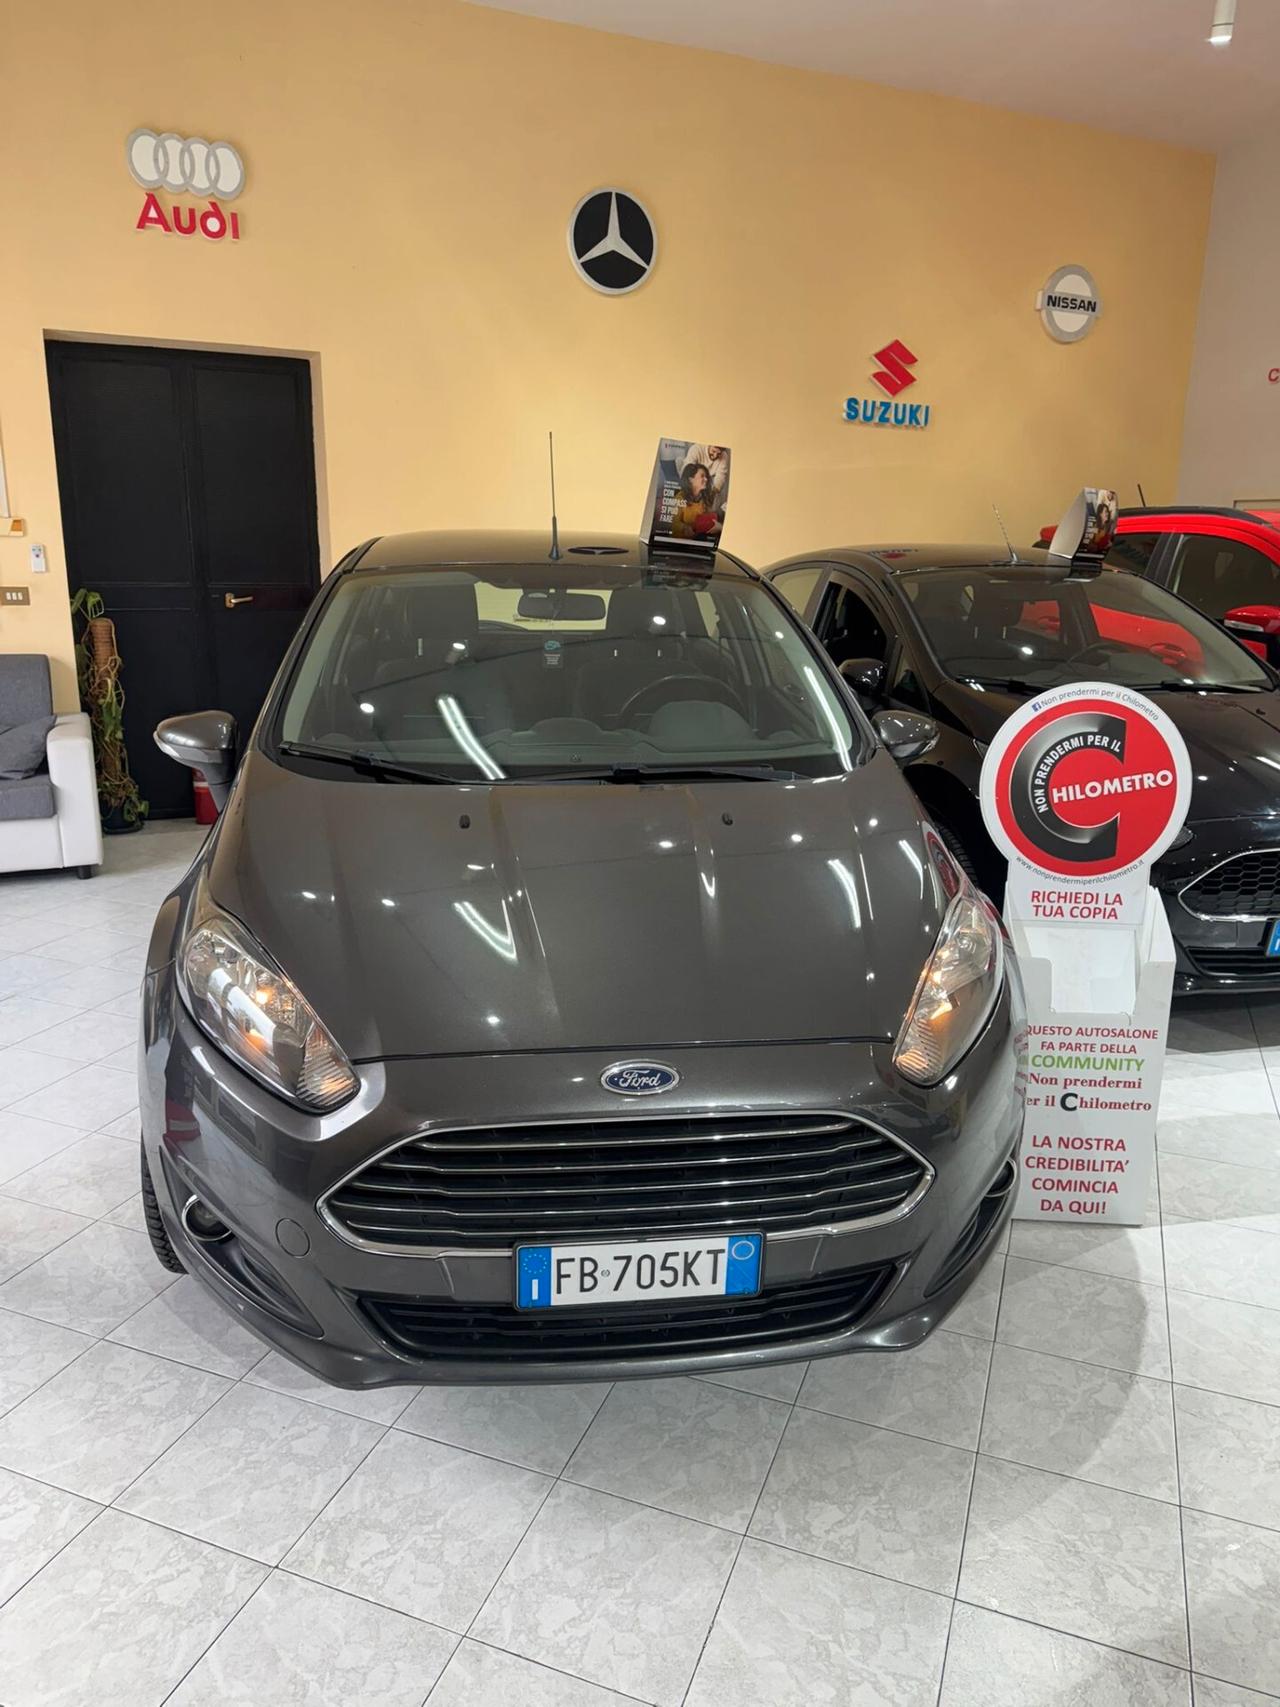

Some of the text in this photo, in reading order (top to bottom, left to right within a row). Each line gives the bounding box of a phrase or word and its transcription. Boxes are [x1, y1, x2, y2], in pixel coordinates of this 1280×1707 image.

[1046, 294, 1097, 313] NISSAN
[844, 397, 930, 427] SUZUKI
[1040, 694, 1058, 708] Non
[1058, 687, 1101, 701] prendermi
[1101, 689, 1115, 698] per
[1122, 693, 1160, 721] Chilometro
[1032, 734, 1123, 813] NON PRENDERMI PER IL
[1031, 890, 1123, 906] RICHIEDI LA
[1033, 904, 1119, 920] TUA COPIA
[1075, 1026, 1159, 1040] AUTOSALONE
[1040, 1040, 1138, 1055] FA PARTE DELLA
[1031, 1054, 1145, 1072] COMMUNITY
[619, 1070, 661, 1087] Ford
[1028, 1072, 1143, 1090] Non prendermi
[1025, 1092, 1152, 1112] er il Chilometro
[1032, 1135, 1127, 1152] LA NOSTRA
[1031, 1177, 1119, 1194] COMINCIA
[1040, 1199, 1106, 1215] DA QUI!
[531, 1279, 539, 1301] I
